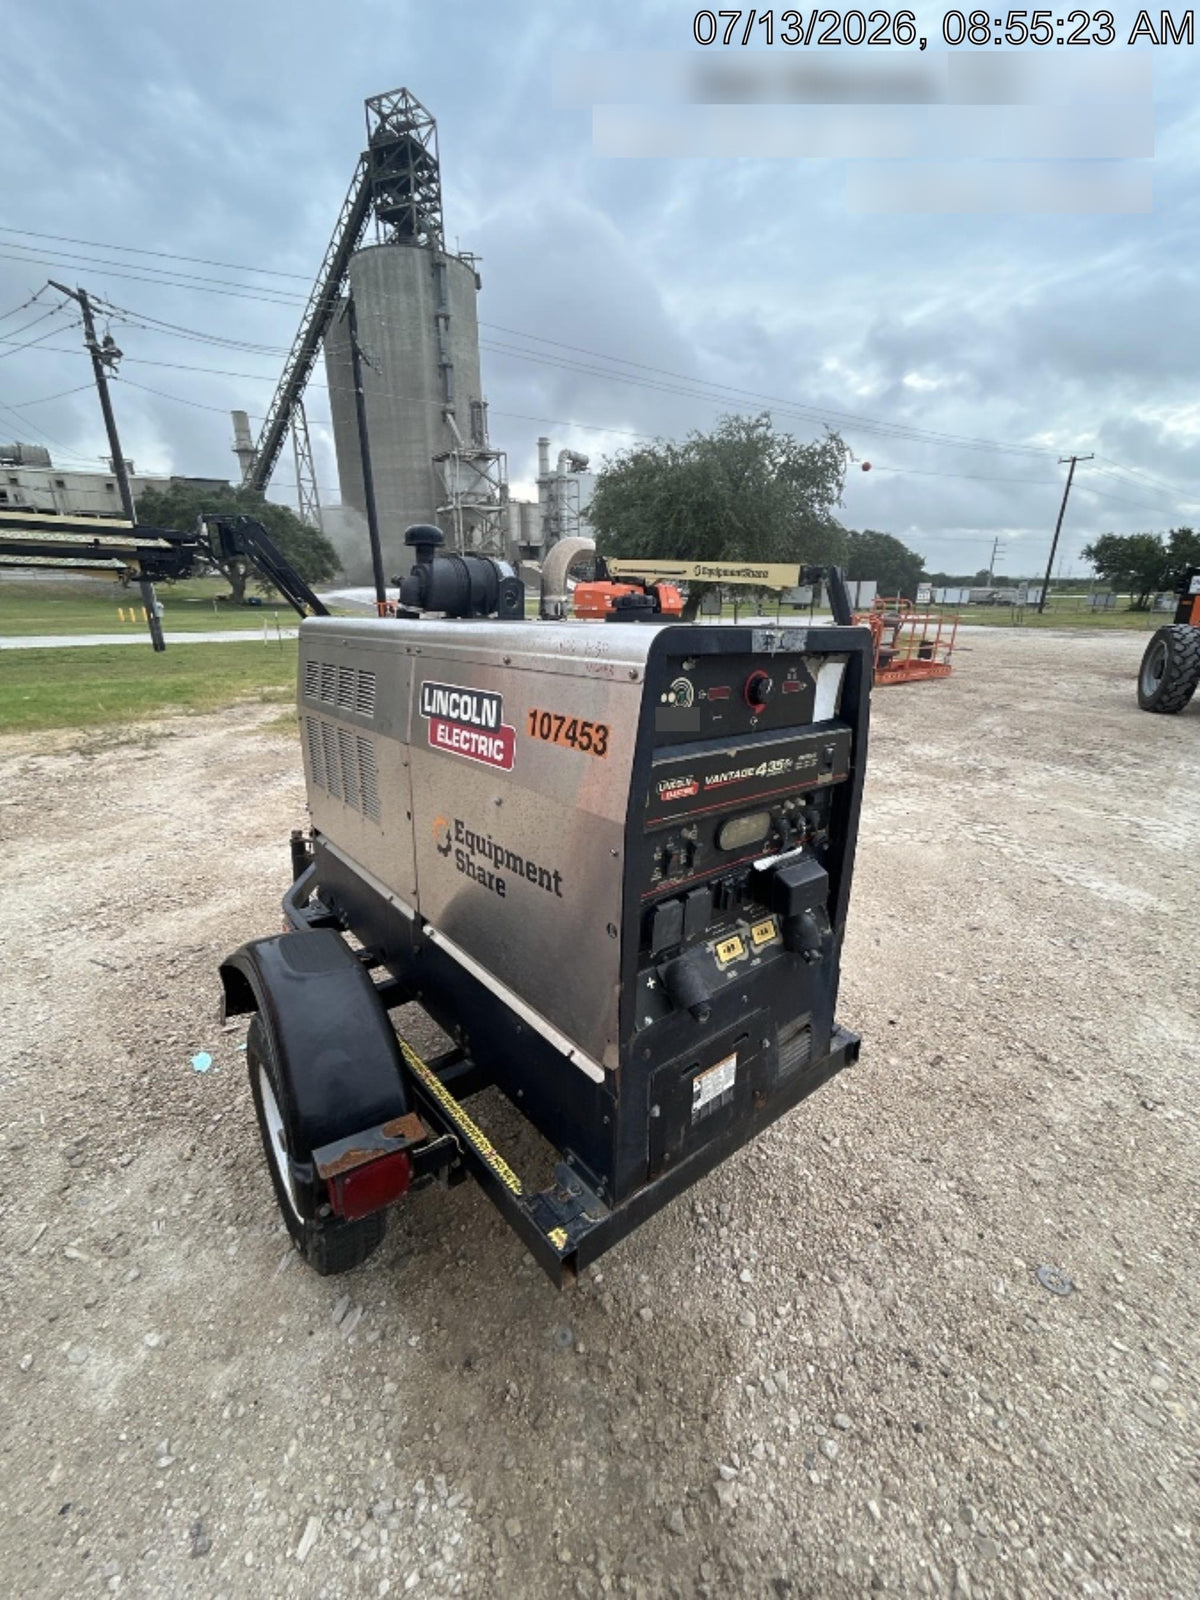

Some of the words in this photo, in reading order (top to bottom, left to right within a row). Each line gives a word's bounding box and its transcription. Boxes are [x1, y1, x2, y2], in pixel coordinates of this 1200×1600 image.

[423, 687, 497, 728] LINCOLN
[437, 724, 504, 762] ELECTRIC
[529, 709, 609, 756] 107453
[454, 819, 563, 898] Equipment
[455, 846, 506, 898] Share
